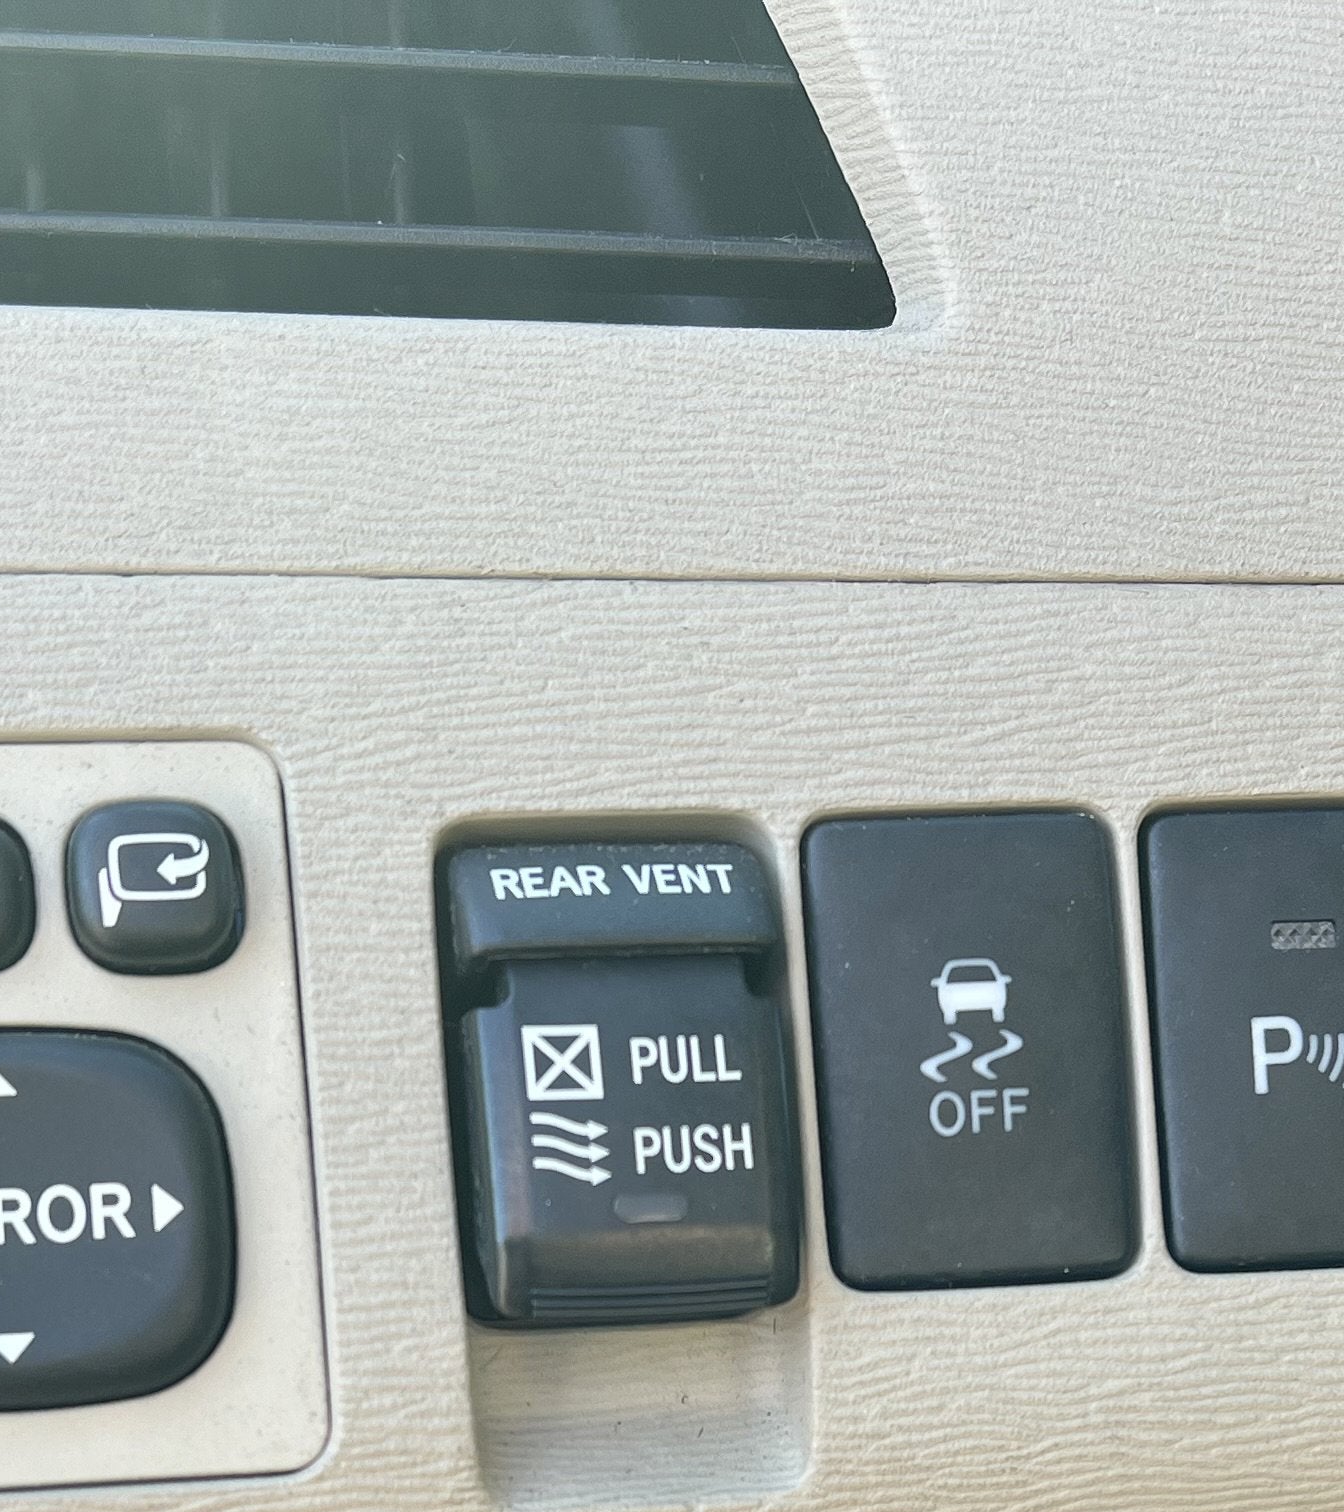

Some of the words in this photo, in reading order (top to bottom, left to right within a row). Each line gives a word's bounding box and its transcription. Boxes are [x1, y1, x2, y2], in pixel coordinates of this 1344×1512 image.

[489, 863, 612, 901] REAR
[621, 862, 734, 896] VENT
[629, 1032, 743, 1086] PULL
[1249, 1014, 1304, 1096] P
[928, 1086, 1030, 1138] OFF
[632, 1121, 755, 1176] PUSH
